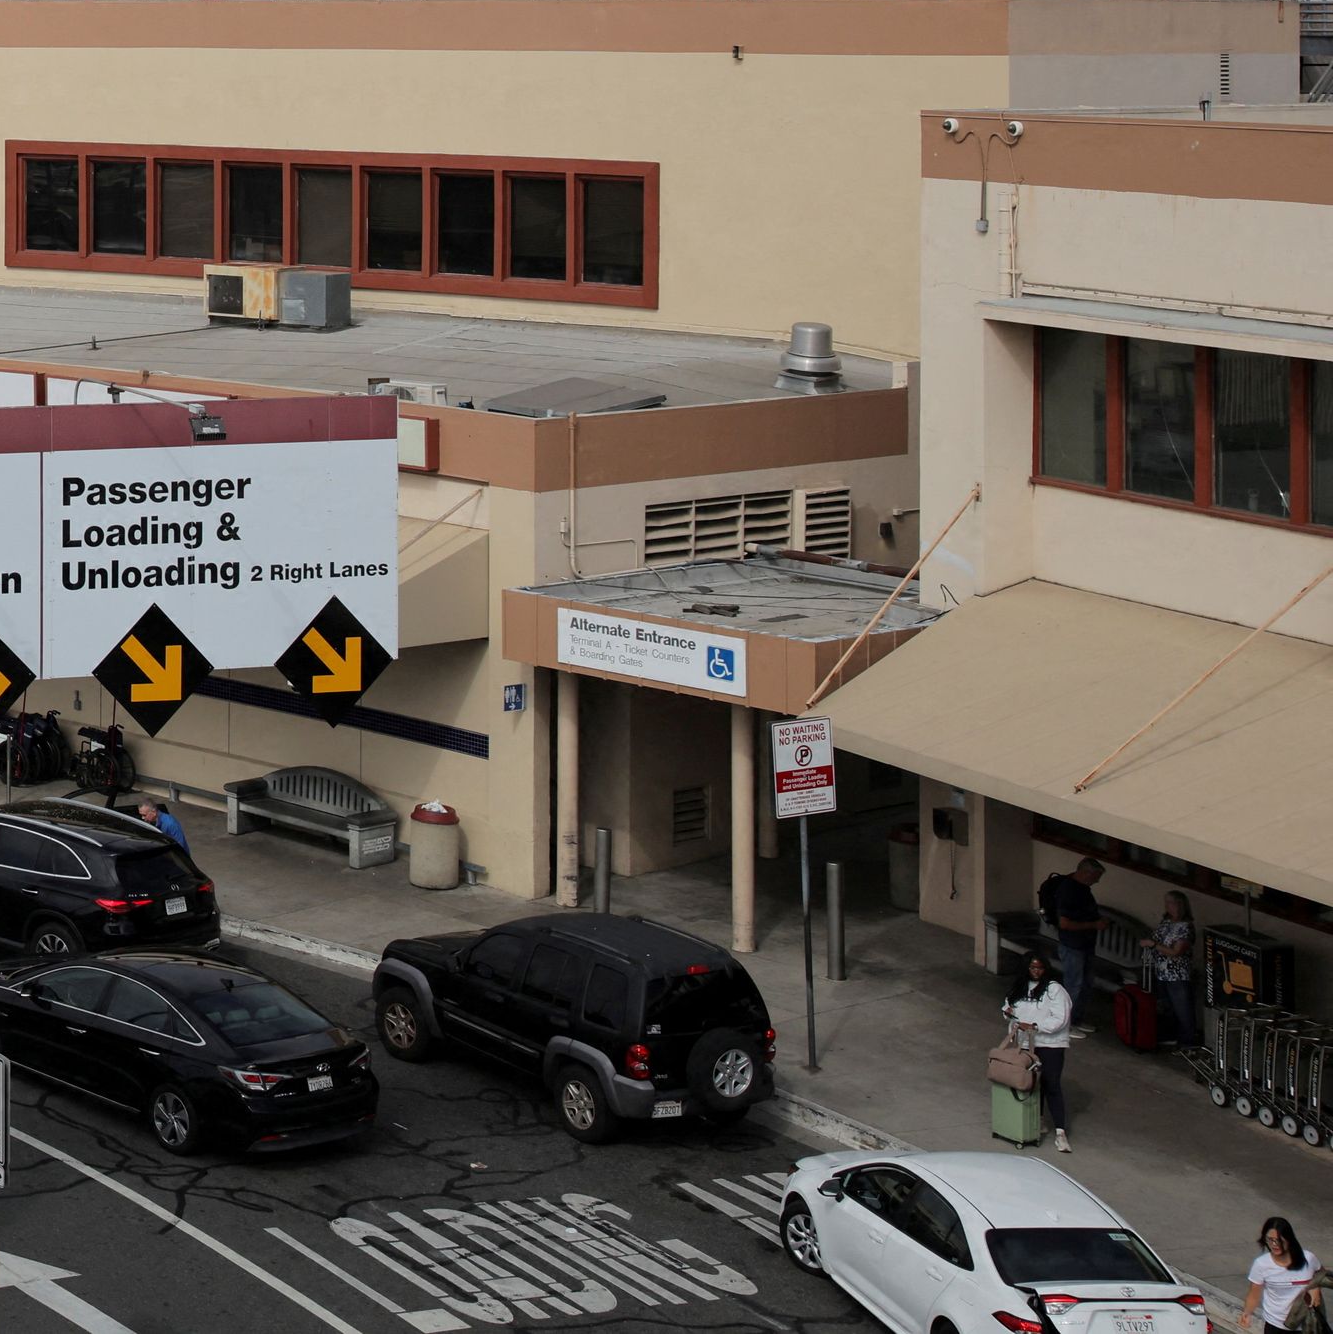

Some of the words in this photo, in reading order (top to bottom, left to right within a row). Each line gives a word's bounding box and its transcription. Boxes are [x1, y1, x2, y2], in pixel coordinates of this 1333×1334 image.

[62, 476, 251, 507] Passenger
[61, 515, 204, 549] Loading
[216, 512, 241, 542] &
[61, 556, 241, 590] Unloading
[250, 566, 263, 582] 2
[270, 563, 323, 584] Right
[329, 561, 389, 579] Lanes
[569, 616, 631, 639] Alternate
[635, 627, 697, 650] Entrance
[569, 634, 602, 649] Terminal
[605, 640, 612, 649] A
[624, 643, 648, 657] Ticket
[651, 648, 691, 665] Counters
[569, 647, 576, 656] &
[579, 647, 616, 664] Boarding
[618, 654, 643, 668] Gates
[779, 727, 791, 737] NO
[792, 723, 825, 735] WAITING
[779, 737, 791, 746] NO
[792, 732, 826, 744] PARKING
[1241, 944, 1257, 960] CARTS
[1116, 1320, 1155, 1333] 9LTV297
